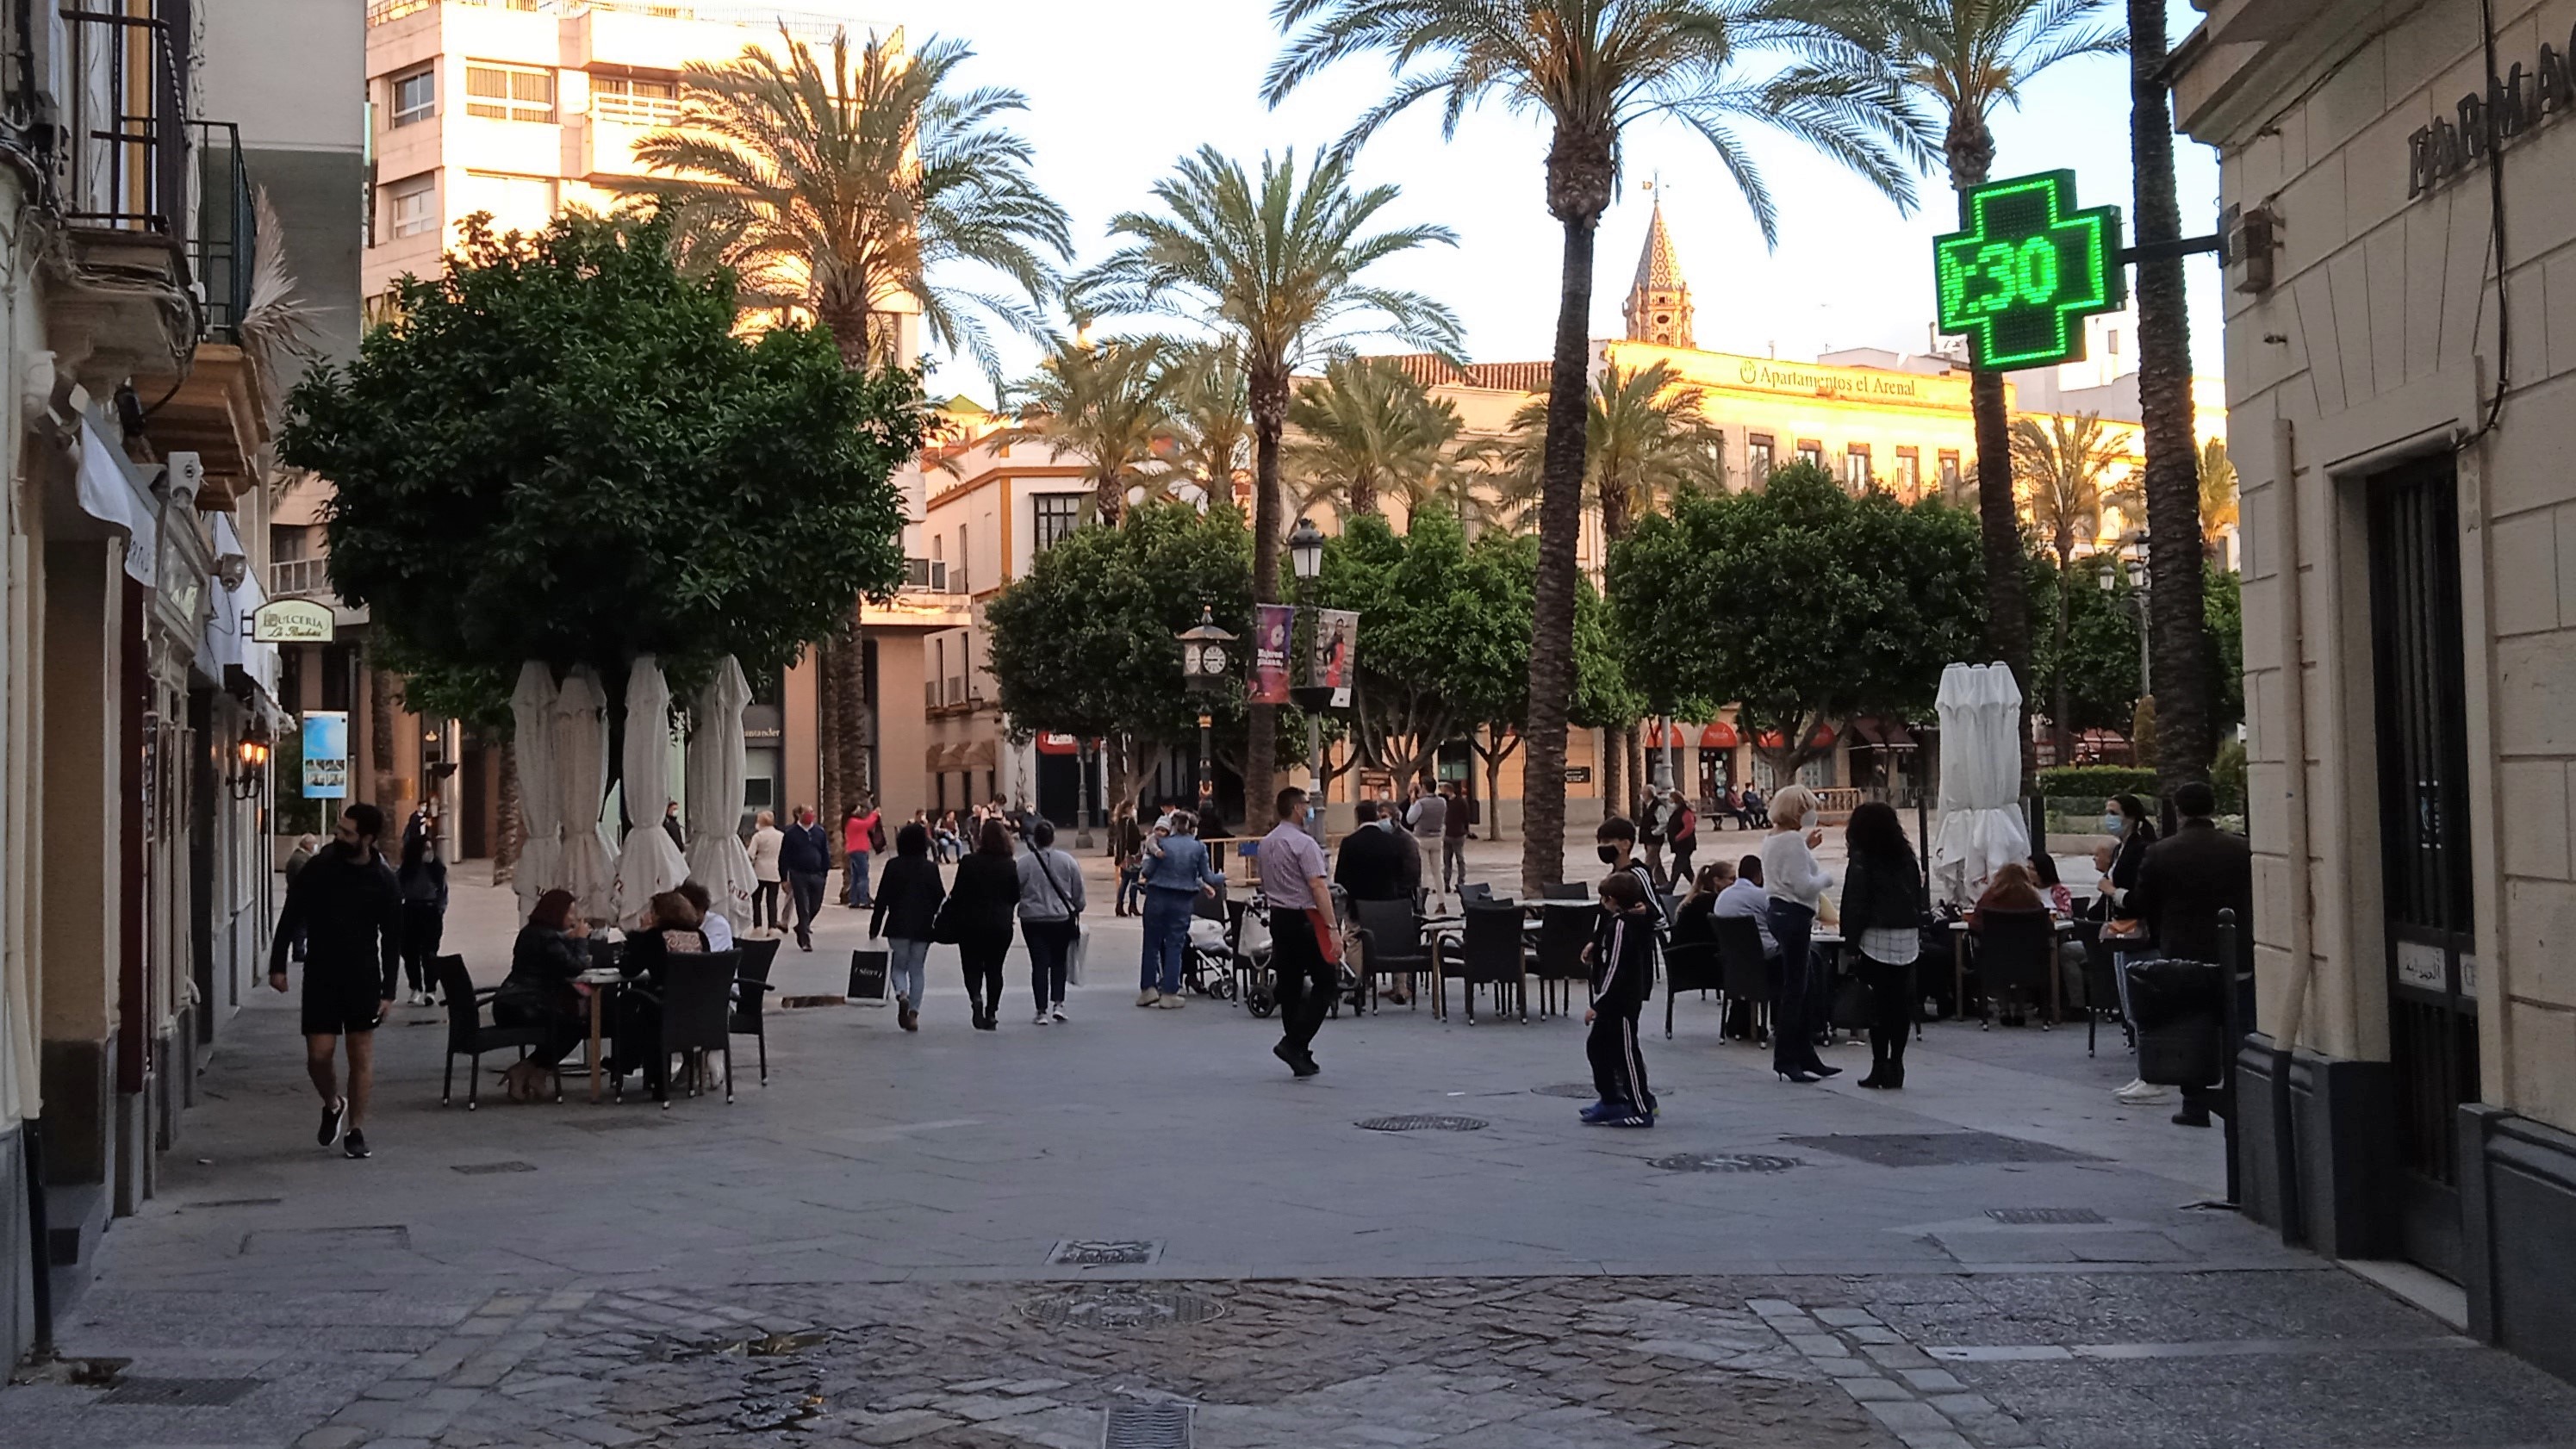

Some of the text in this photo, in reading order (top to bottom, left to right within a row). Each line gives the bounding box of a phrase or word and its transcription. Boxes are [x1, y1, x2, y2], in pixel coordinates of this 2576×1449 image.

[2408, 19, 2576, 201] FARMA
[1760, 365, 1915, 396] Apartamentos el Arenal
[744, 727, 780, 737] antander
